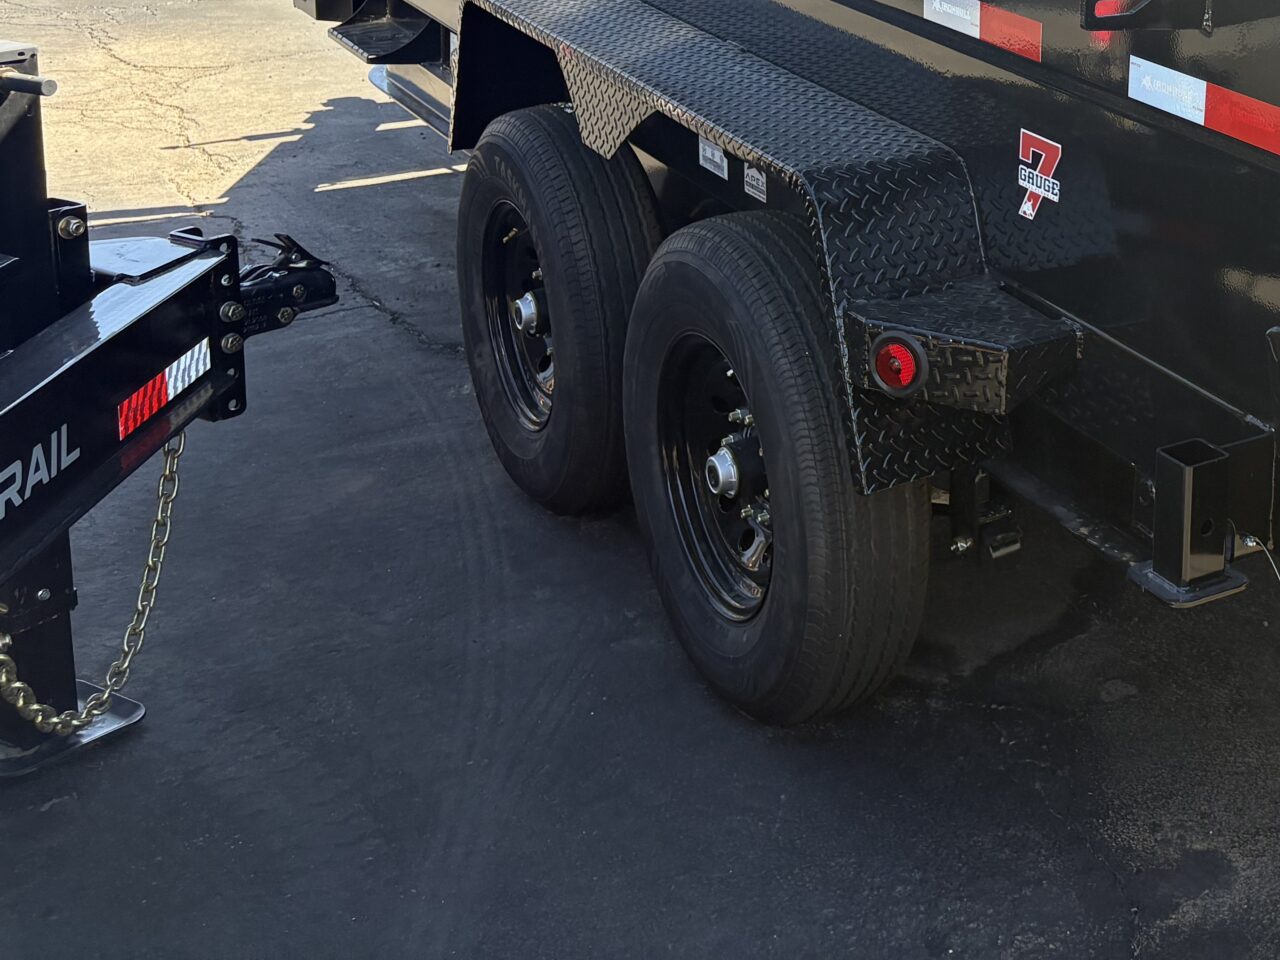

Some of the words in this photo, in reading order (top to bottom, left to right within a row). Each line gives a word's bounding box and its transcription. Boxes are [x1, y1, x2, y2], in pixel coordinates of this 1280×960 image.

[745, 172, 766, 188] APEX
[1019, 166, 1059, 197] GAUGE
[0, 423, 80, 520] RAIL
